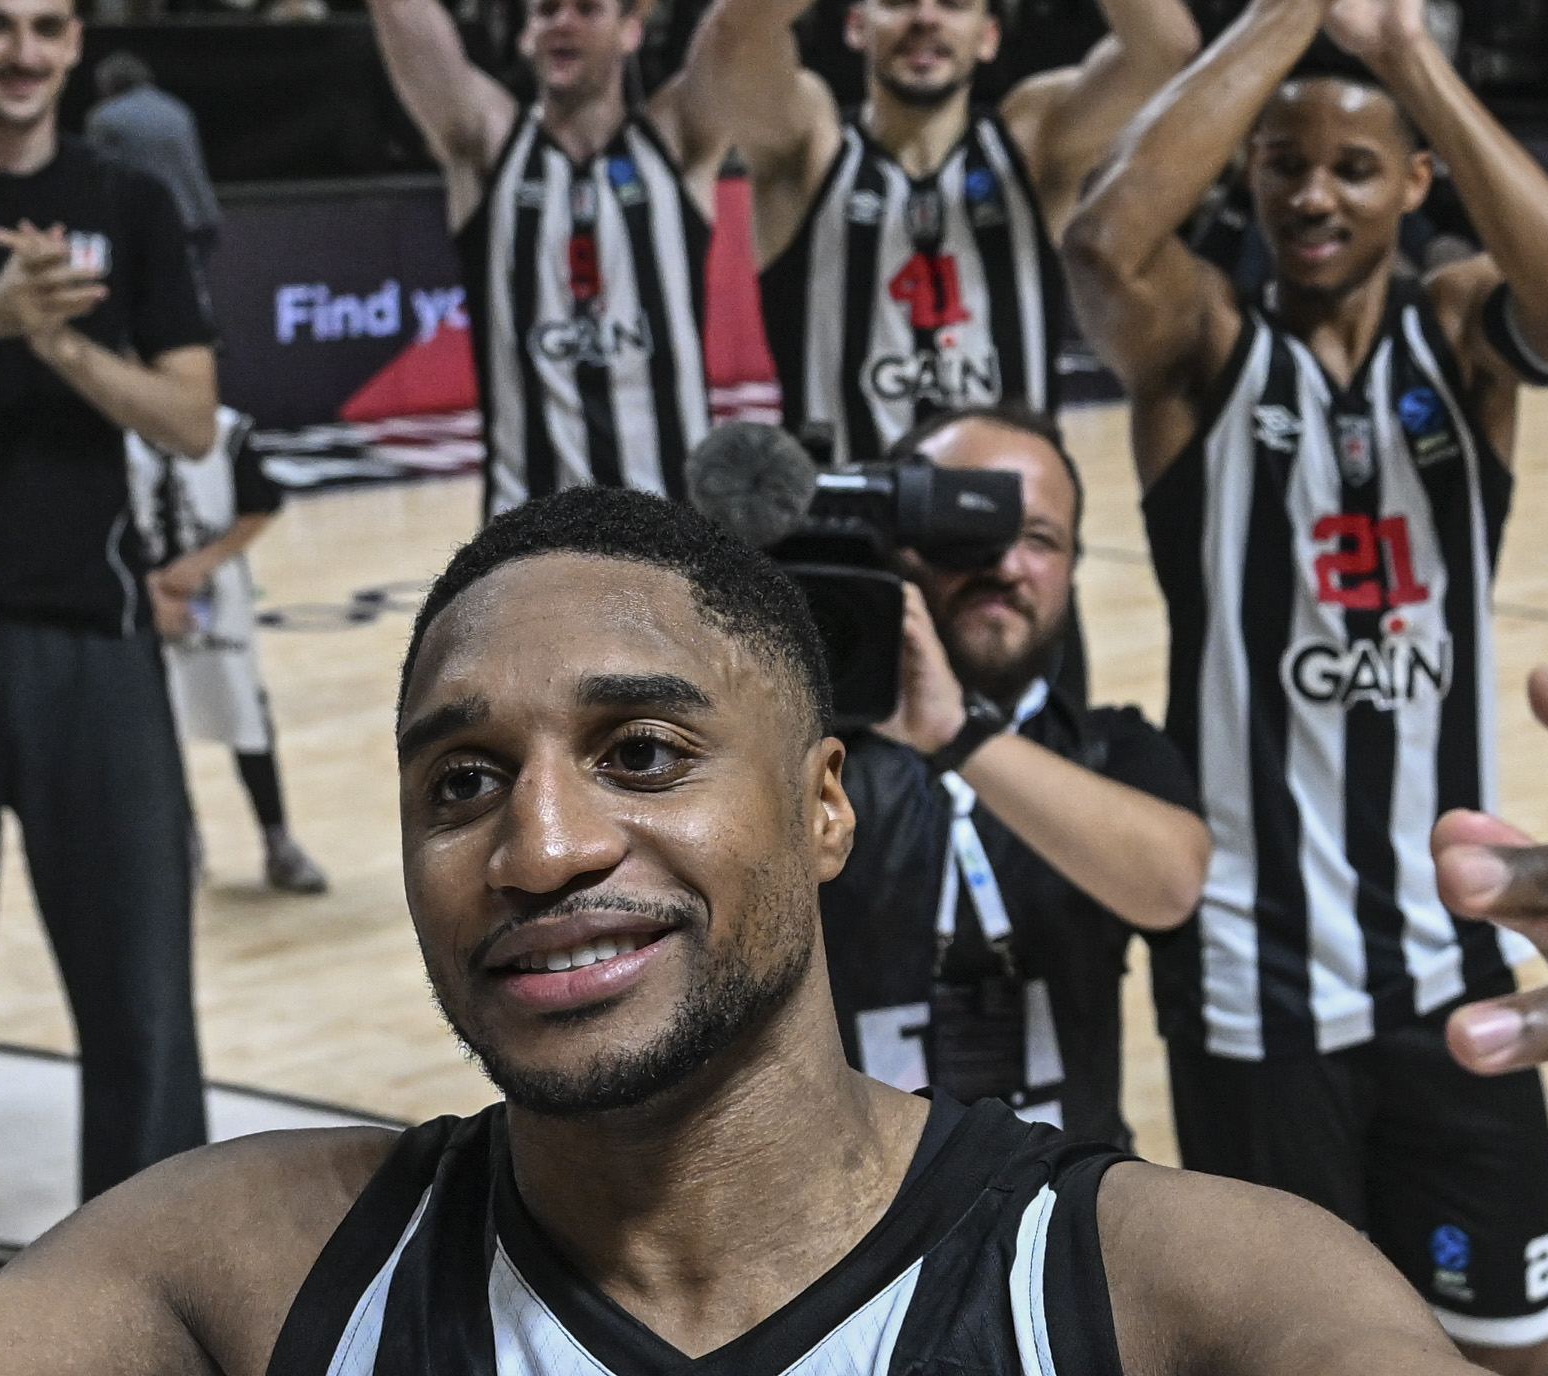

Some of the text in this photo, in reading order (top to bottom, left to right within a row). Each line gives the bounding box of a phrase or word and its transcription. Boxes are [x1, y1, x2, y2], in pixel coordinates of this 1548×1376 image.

[274, 279, 401, 345] Find
[888, 252, 972, 330] 41
[1312, 513, 1429, 610] 21
